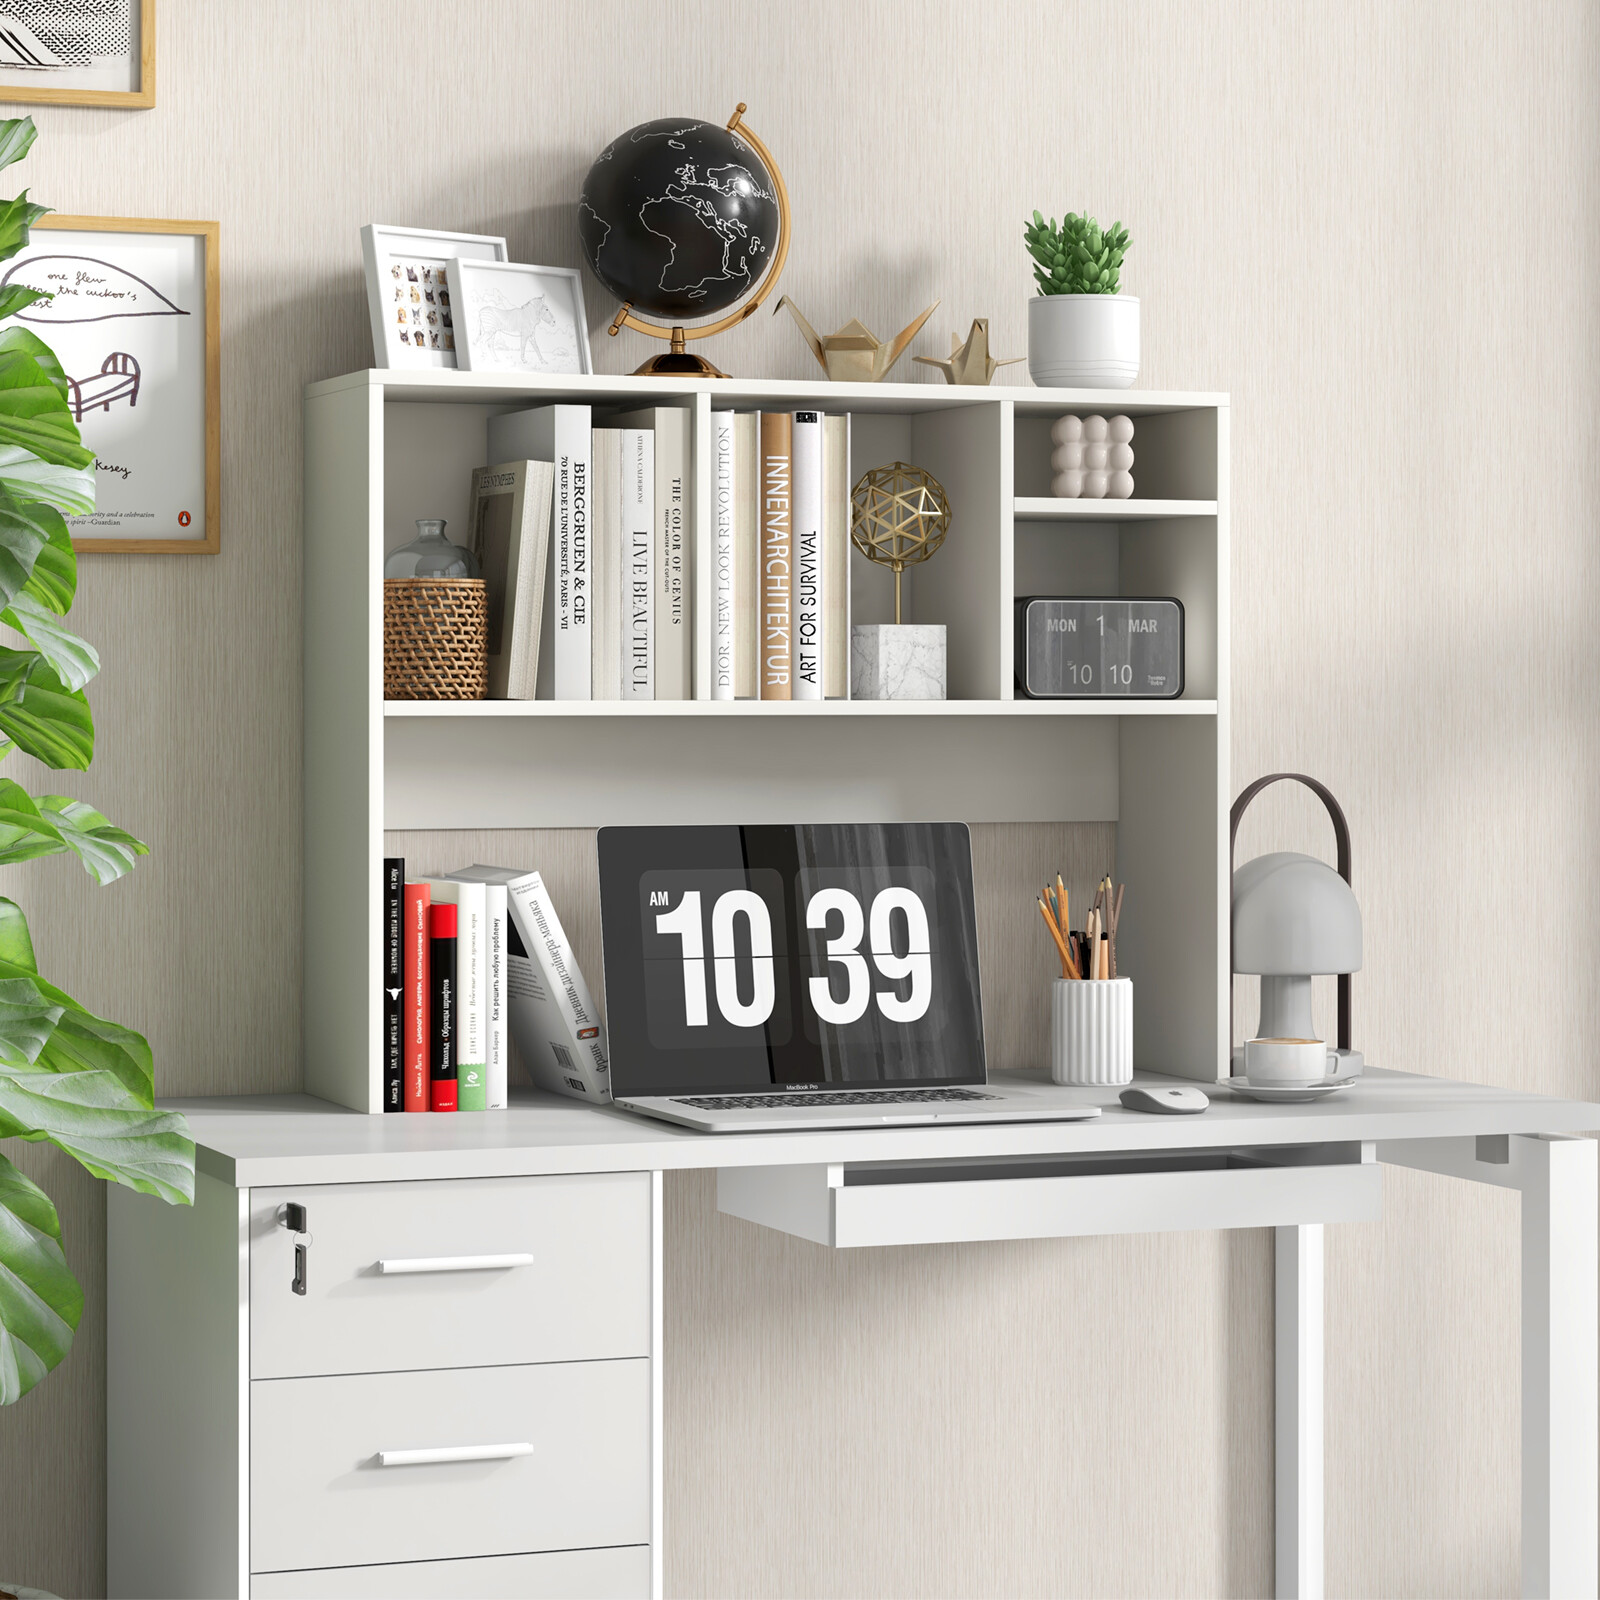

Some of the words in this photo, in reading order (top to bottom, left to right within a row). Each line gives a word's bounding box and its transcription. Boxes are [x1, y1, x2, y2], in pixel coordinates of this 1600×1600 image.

[47, 273, 68, 281] one
[75, 270, 107, 286] flew
[56, 284, 79, 297] the
[85, 288, 137, 301] cuckoo's
[30, 299, 53, 309] est
[95, 459, 132, 480] Kesey
[560, 456, 569, 468] 70
[560, 469, 569, 490] RUE
[672, 477, 682, 503] THE
[718, 426, 730, 538] REVOLUTION
[560, 491, 569, 506] DE
[573, 461, 586, 573] BERGGRUEN
[672, 508, 682, 551] COLOR
[633, 530, 648, 575] LIVE
[672, 556, 682, 573] OF
[718, 544, 730, 591] LOOK
[766, 455, 789, 685] INNENARCHITEKTUR
[799, 530, 817, 606] SURVIVAL
[560, 579, 569, 608] PARIS
[573, 577, 586, 591] &
[573, 595, 586, 625] CIE
[672, 578, 682, 625] GENIUS
[718, 596, 730, 635] NEW
[560, 615, 569, 630] VII
[633, 581, 648, 692] BEAUTIFUL
[799, 612, 817, 646] FOR
[1047, 618, 1077, 632] MON
[1096, 615, 1105, 636] 1
[1128, 619, 1158, 633] MAR
[718, 640, 730, 687] DIOR.
[799, 652, 817, 684] ART
[1069, 664, 1093, 685] 10
[1109, 664, 1133, 685] 10
[390, 867, 399, 881] Alice
[390, 882, 399, 890] Lu
[649, 891, 669, 906] AM
[491, 918, 500, 953] проблему
[528, 900, 575, 986] дизайнера-маньяка
[491, 954, 500, 979] любую
[655, 889, 776, 1028] 10
[805, 887, 932, 1025] 39
[441, 979, 451, 1009] шрифтов
[492, 980, 500, 1007] решить
[565, 984, 591, 1024] Дневник
[441, 1009, 451, 1038] Образцы
[492, 1030, 500, 1050] Баркер
[441, 1042, 450, 1070] Чихольд
[589, 1043, 608, 1073] Франк
